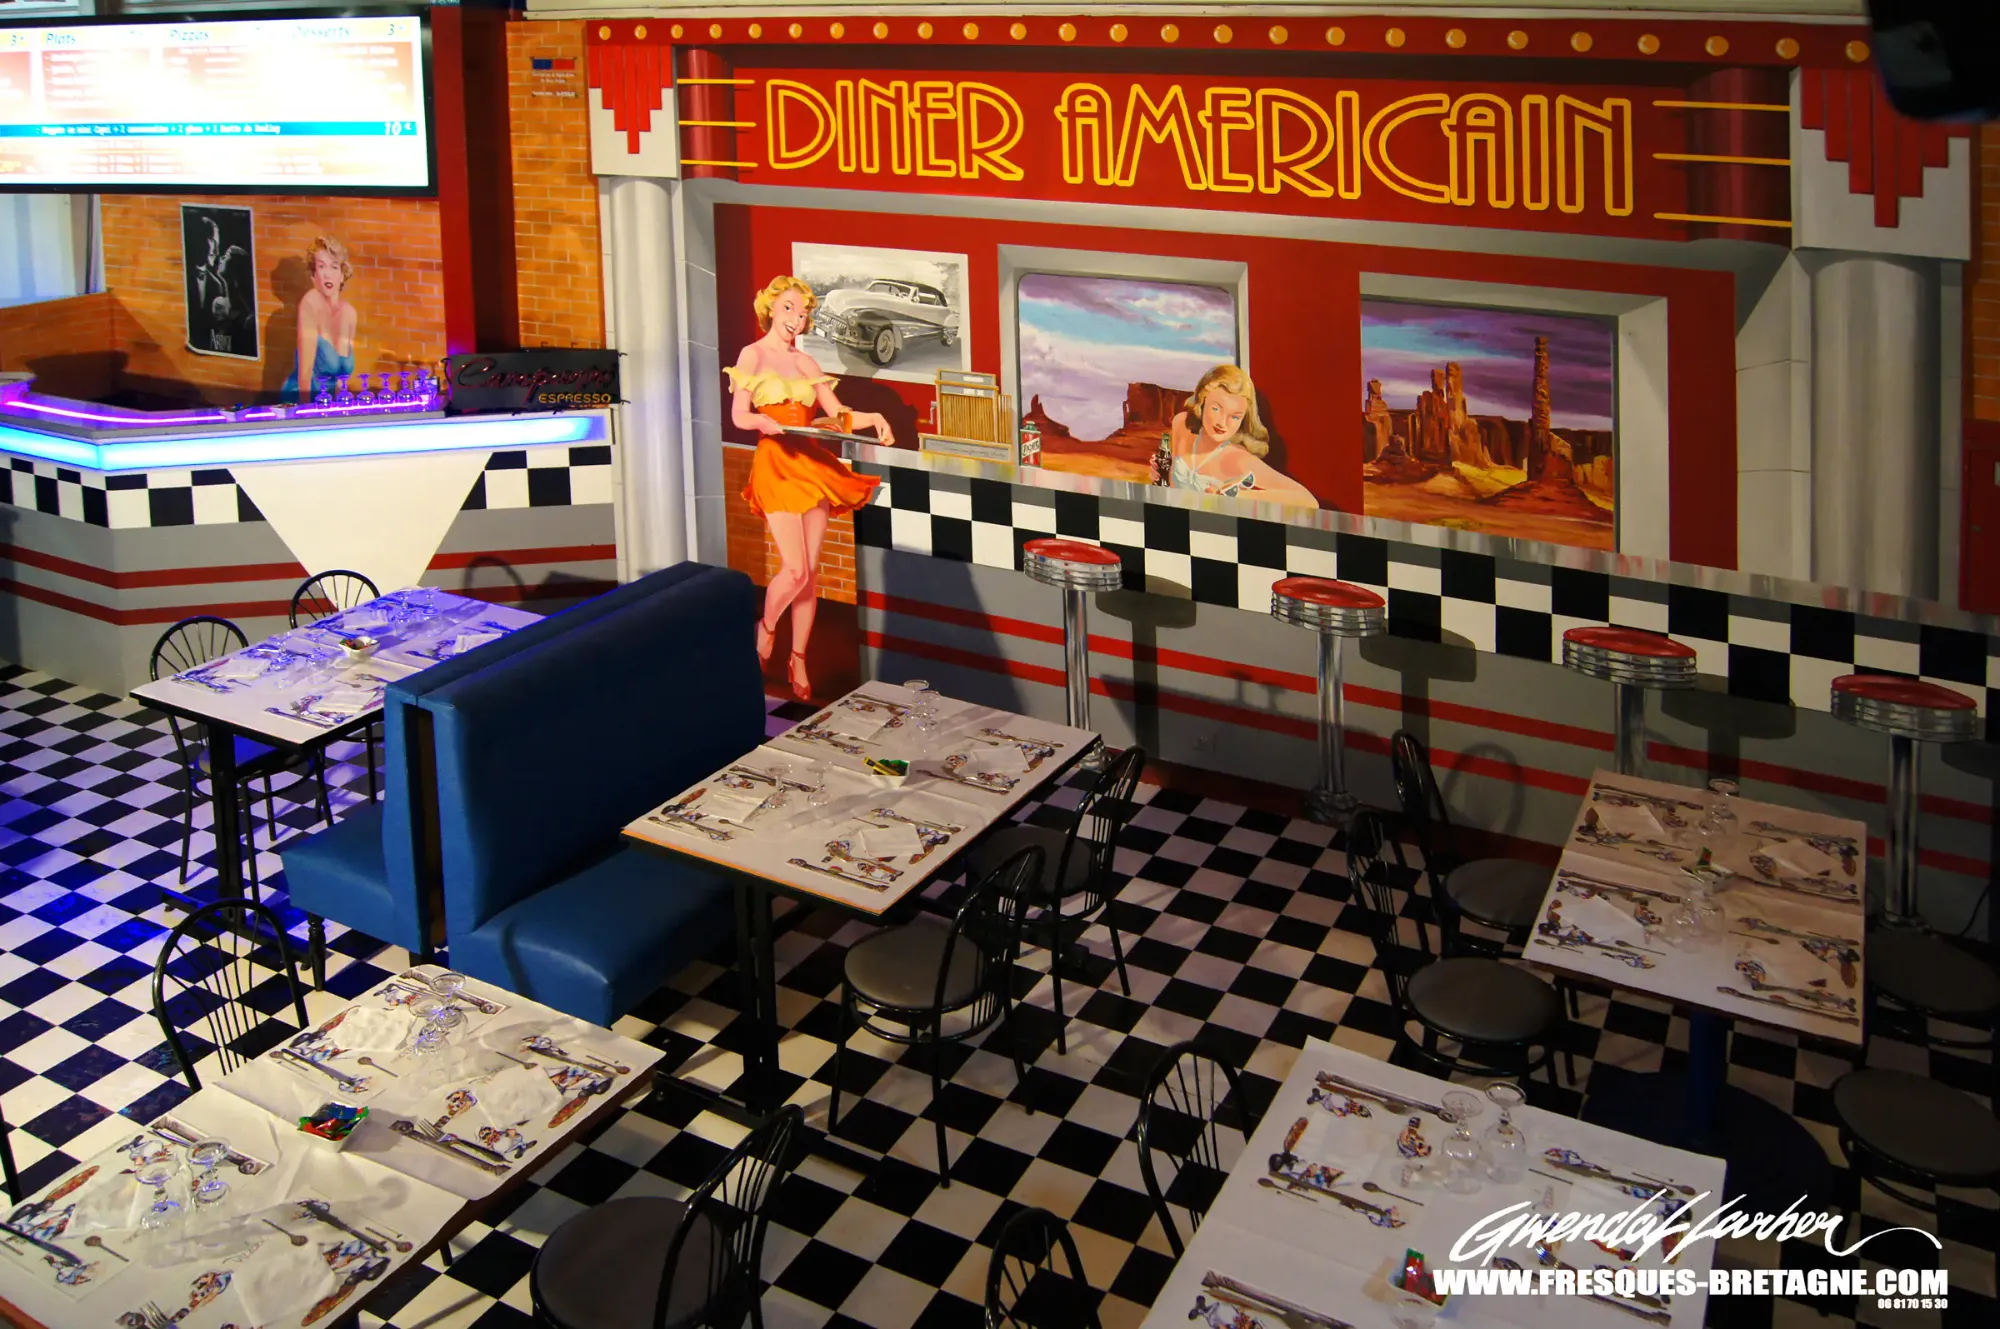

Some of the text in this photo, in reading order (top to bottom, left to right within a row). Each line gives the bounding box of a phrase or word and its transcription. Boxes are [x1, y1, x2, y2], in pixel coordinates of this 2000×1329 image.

[46, 31, 76, 45] Plats
[766, 78, 1634, 217] DINER AMERICAIN
[538, 393, 611, 404] ESPRESSO
